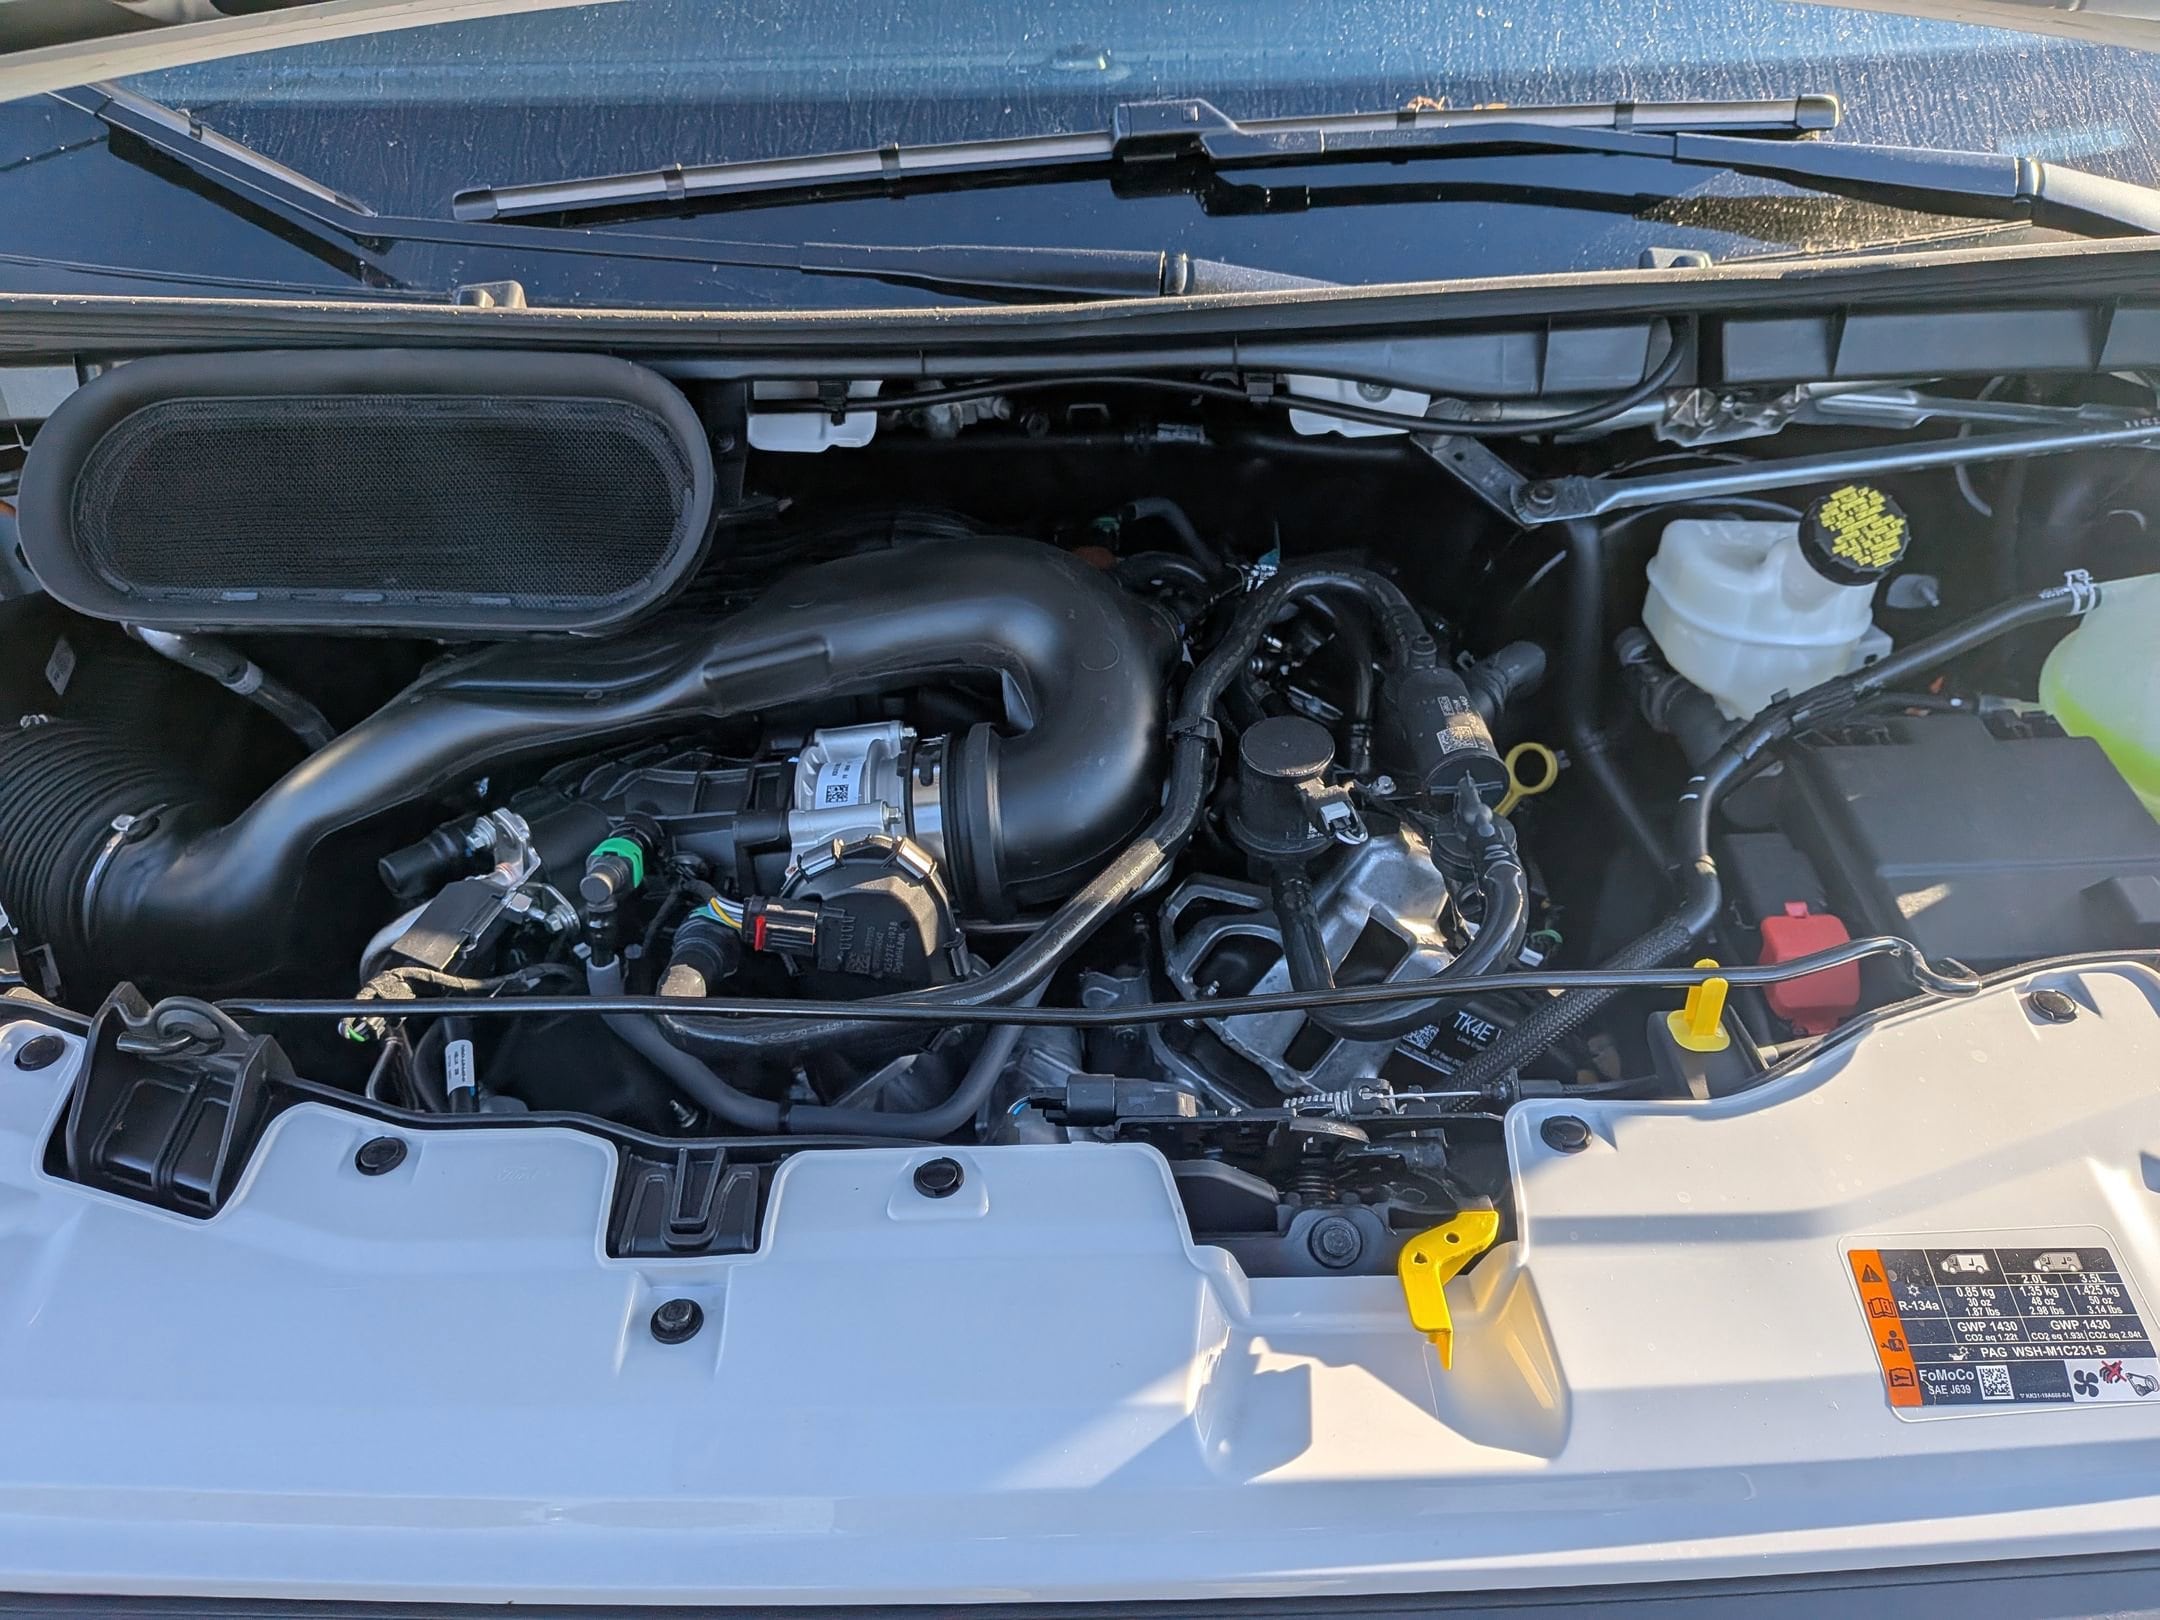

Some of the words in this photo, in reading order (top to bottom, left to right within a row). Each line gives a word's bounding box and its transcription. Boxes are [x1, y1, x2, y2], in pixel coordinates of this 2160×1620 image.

[1452, 1010, 1495, 1042] TK4E
[2021, 1274, 2047, 1284] 2.0L
[2079, 1273, 2105, 1283] 3.5L
[1956, 1287, 1979, 1297] 0.85
[1981, 1286, 1996, 1299] kg
[2020, 1285, 2043, 1297] 1.35
[2043, 1285, 2059, 1298] kg
[2074, 1285, 2103, 1296] 1.425
[2104, 1284, 2120, 1297] kg
[1898, 1300, 1940, 1311] R-134a
[1967, 1298, 1979, 1307] 30
[2031, 1296, 2041, 1305] 48
[2088, 1296, 2100, 1305] 50
[2102, 1297, 2114, 1305] oz
[1965, 1307, 1984, 1316] 1.87
[1986, 1307, 2001, 1316] lbs
[2029, 1306, 2049, 1315] 2.98
[2050, 1305, 2065, 1315] lbs
[2087, 1305, 2107, 1314] 3.14
[2108, 1305, 2123, 1314] lbs
[1957, 1321, 1986, 1332] GWP
[1989, 1321, 2018, 1331] 1430
[2050, 1320, 2079, 1330] GWP
[2083, 1319, 2111, 1329] 1430
[1965, 1333, 1984, 1341] CO2
[1985, 1334, 1996, 1343] eq
[1998, 1333, 2019, 1341] 1.22t
[2031, 1332, 2050, 1341] CO2
[2051, 1333, 2063, 1342] eq
[2064, 1332, 2085, 1340] 1.93t
[2088, 1332, 2107, 1340] CO2
[2108, 1333, 2120, 1341] eq
[2120, 1331, 2142, 1339] 2.04t
[1980, 1347, 2008, 1358] PAG
[2012, 1345, 2107, 1358] WSH-M1C231-B
[1918, 1369, 1975, 1382] FoMoCo
[1928, 1385, 1948, 1395] SAE
[1950, 1384, 1971, 1395] J639
